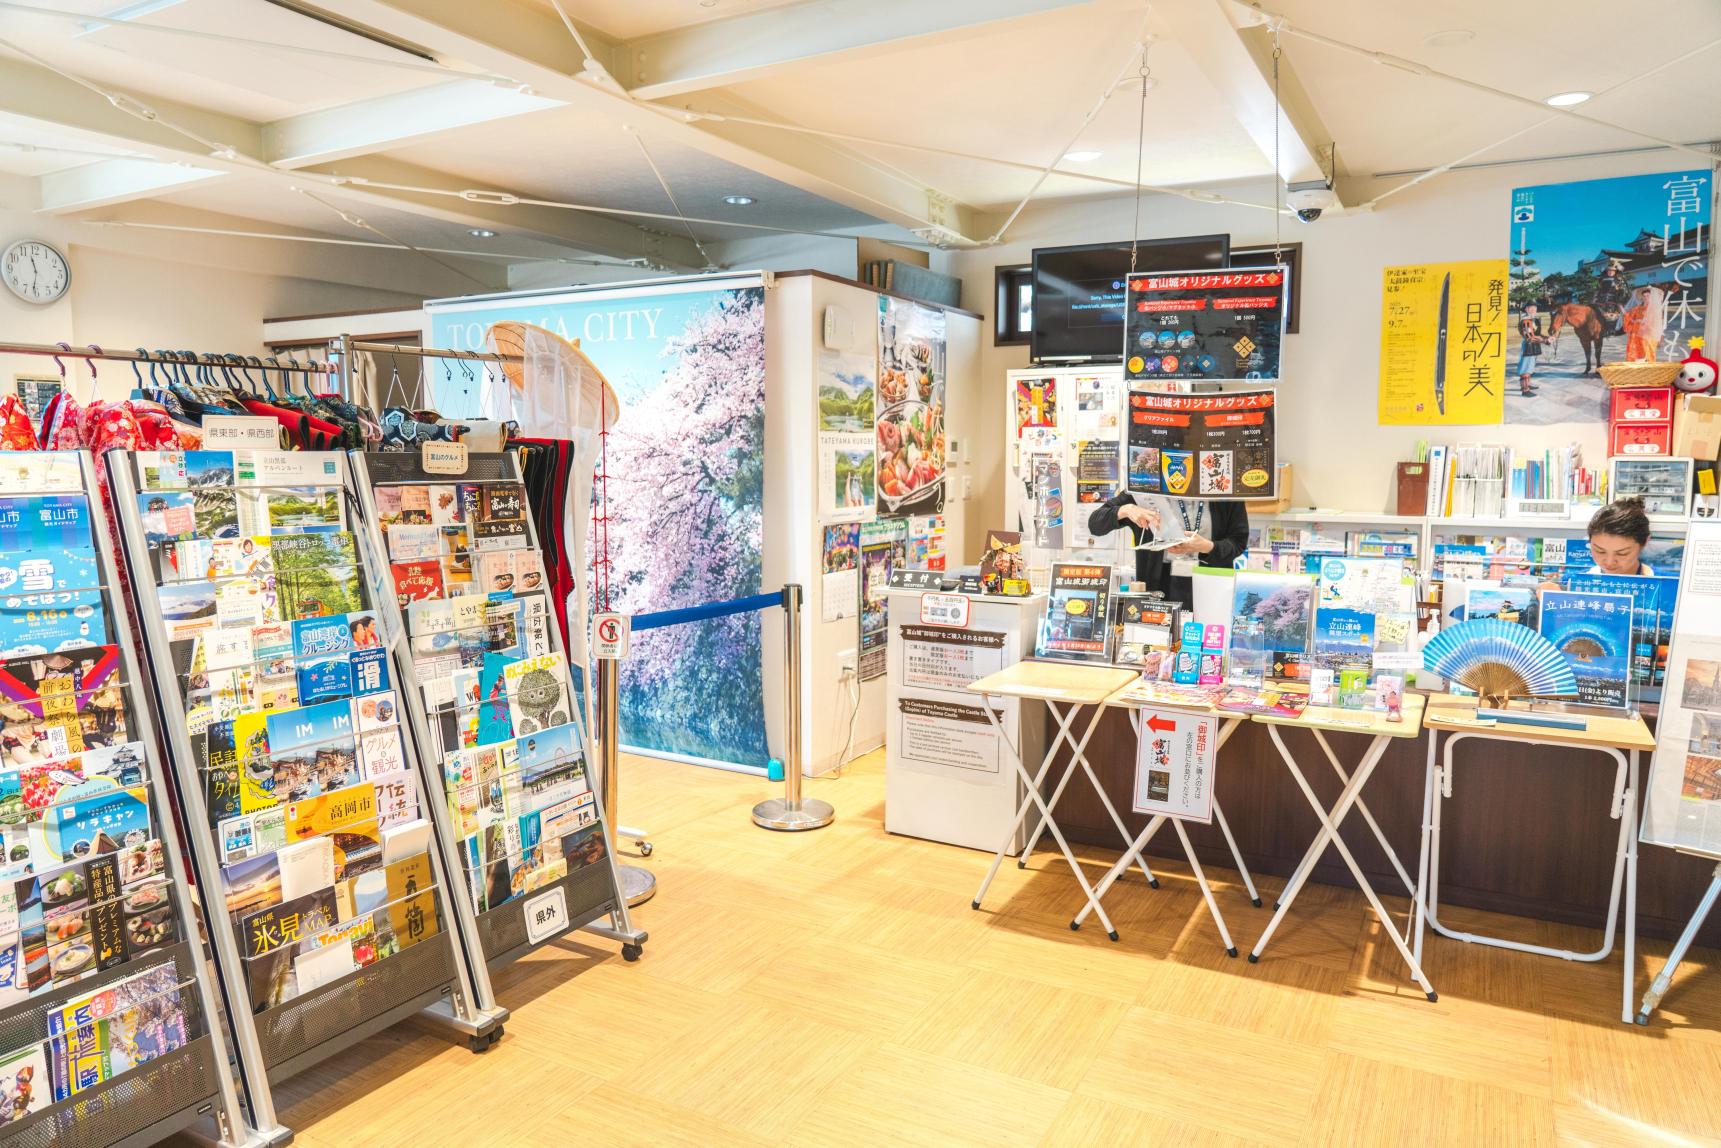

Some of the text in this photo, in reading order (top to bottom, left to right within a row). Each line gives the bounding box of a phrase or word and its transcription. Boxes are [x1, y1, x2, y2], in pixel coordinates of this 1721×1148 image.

[20, 246, 27, 257] 11
[31, 245, 40, 256] 12
[44, 248, 48, 259] 1
[10, 252, 20, 263] 10
[52, 257, 58, 268] 2
[7, 264, 13, 274] 9
[57, 269, 63, 280] 3
[12, 276, 19, 286] 8
[53, 279, 59, 290] 4
[1148, 273, 1266, 289] 富山城オリジナルグッズ
[23, 283, 28, 294] 7
[45, 285, 51, 296] 5
[584, 308, 663, 342] CITY
[1146, 396, 1257, 408] 富山城オリジナルグッズ
[1143, 415, 1175, 423] クリアファイル
[208, 427, 275, 439] 県東部・県西部
[0, 510, 20, 523] 山市
[39, 508, 79, 521] 富山市
[18, 558, 67, 592] 雪で
[532, 602, 544, 656] 県広報と
[303, 639, 350, 655] クルージング
[366, 732, 396, 754] グルメ
[371, 757, 398, 774] 観光
[330, 800, 371, 821] 高岡市
[103, 864, 122, 954] 富山県のプレミアムな
[302, 903, 331, 919] トラベル
[404, 873, 425, 944] 五箇
[535, 903, 557, 925] 県外
[252, 913, 275, 926] 富山県
[254, 912, 302, 955] 氷見
